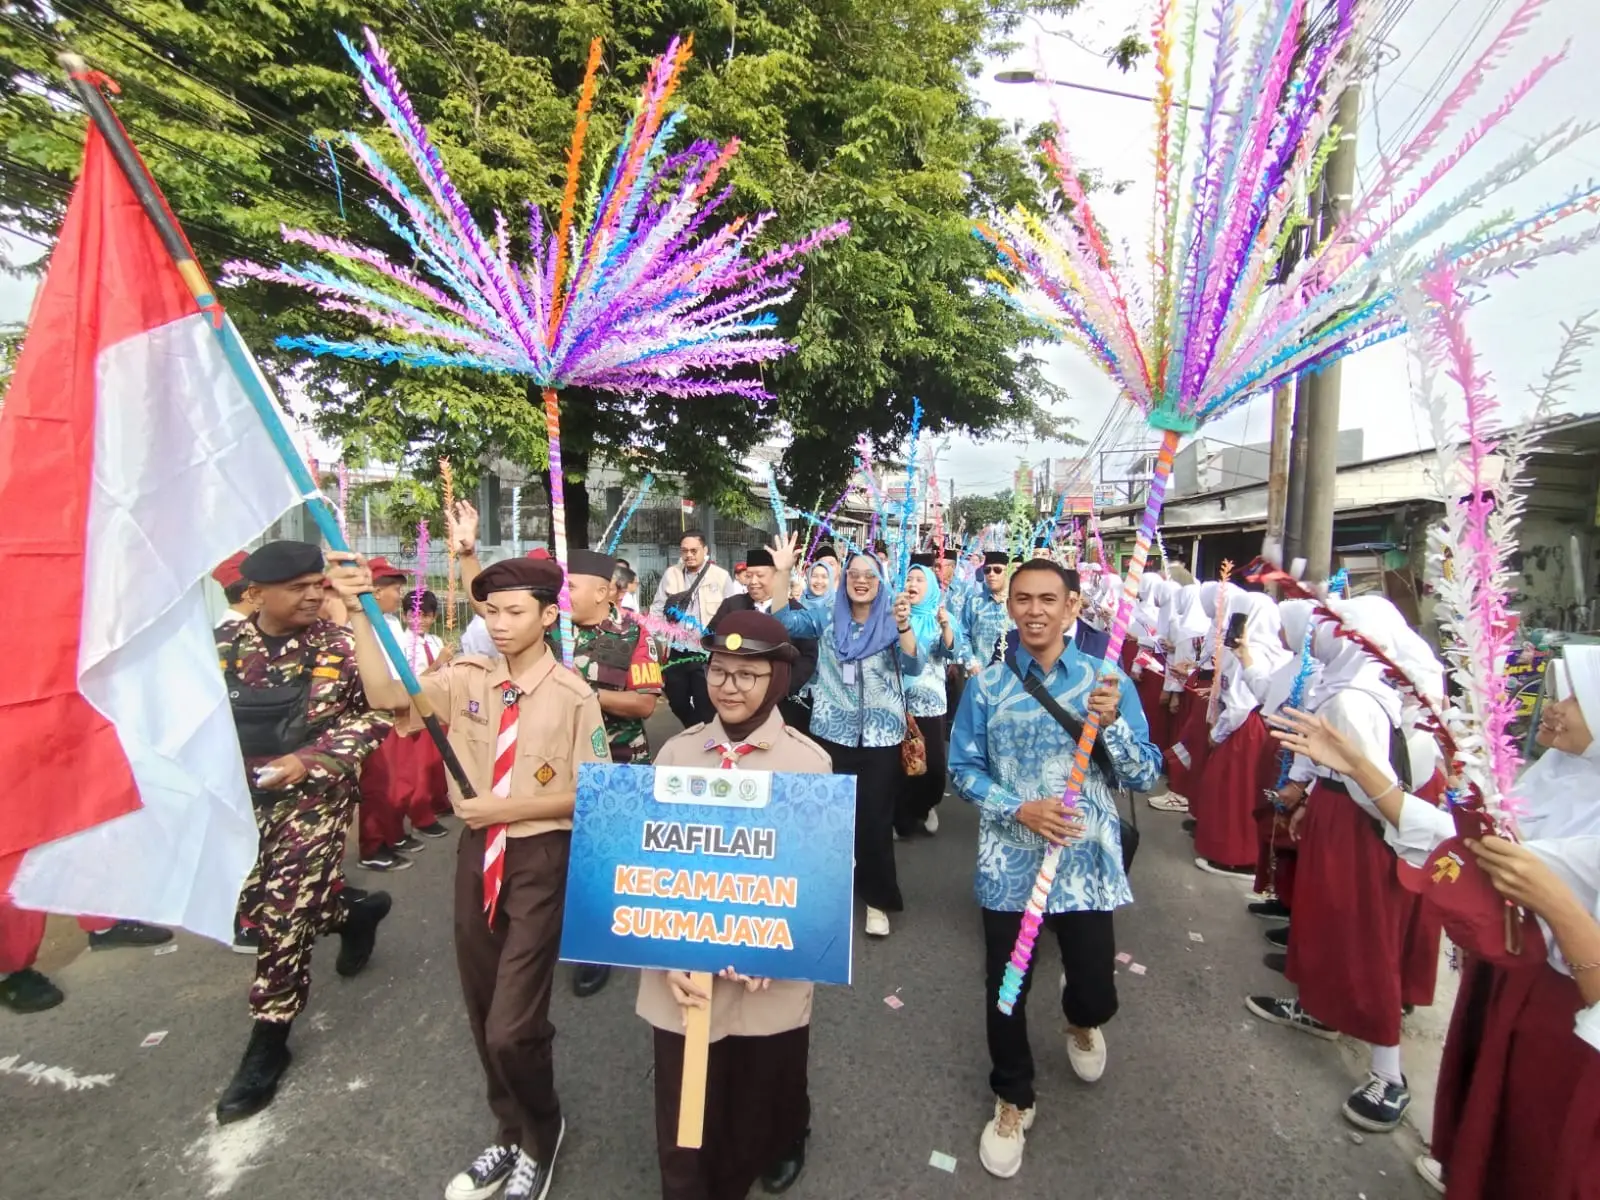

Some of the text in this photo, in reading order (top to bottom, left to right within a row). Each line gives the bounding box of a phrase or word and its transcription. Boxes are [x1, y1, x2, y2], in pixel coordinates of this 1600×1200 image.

[643, 822, 775, 858] KAFILAH
[614, 866, 797, 906] KECAMATAN
[612, 907, 793, 949] SUKMAJAYA
